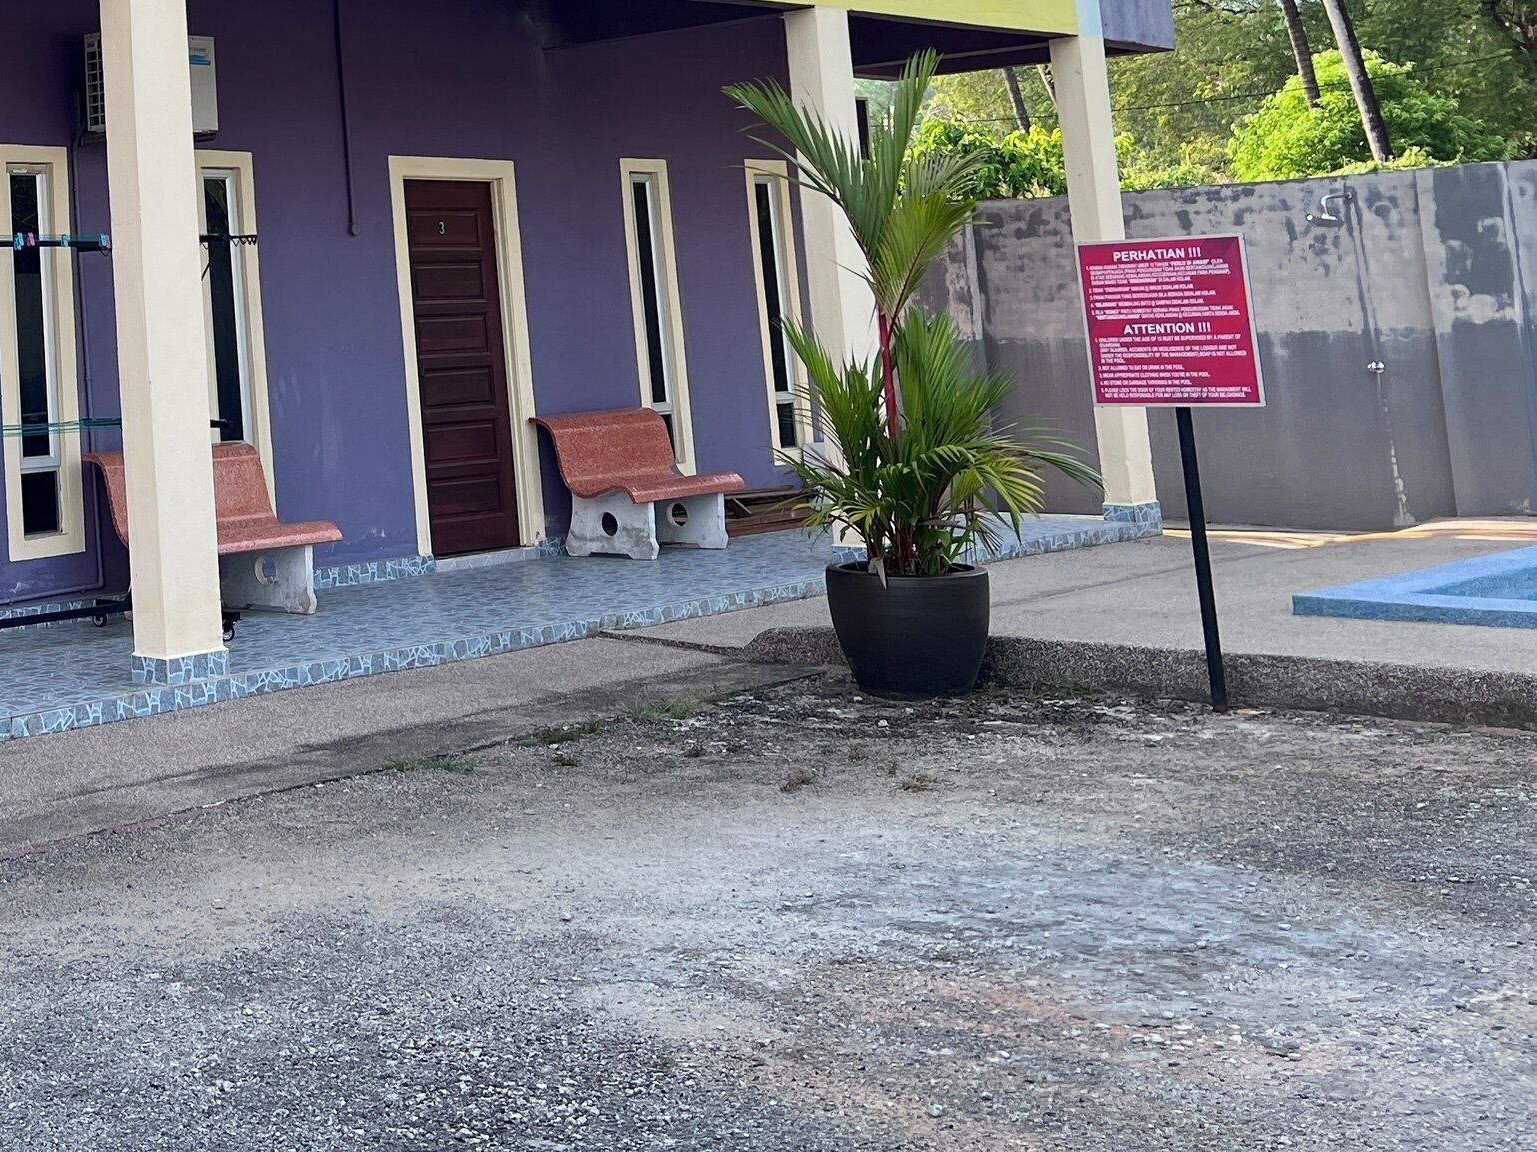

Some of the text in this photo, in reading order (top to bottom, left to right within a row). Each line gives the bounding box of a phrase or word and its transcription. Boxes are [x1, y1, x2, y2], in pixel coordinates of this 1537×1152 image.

[438, 221, 446, 235] 3
[1112, 246, 1201, 261] PERHATIAN !!!
[1122, 322, 1211, 334] ATTENTION !!!
